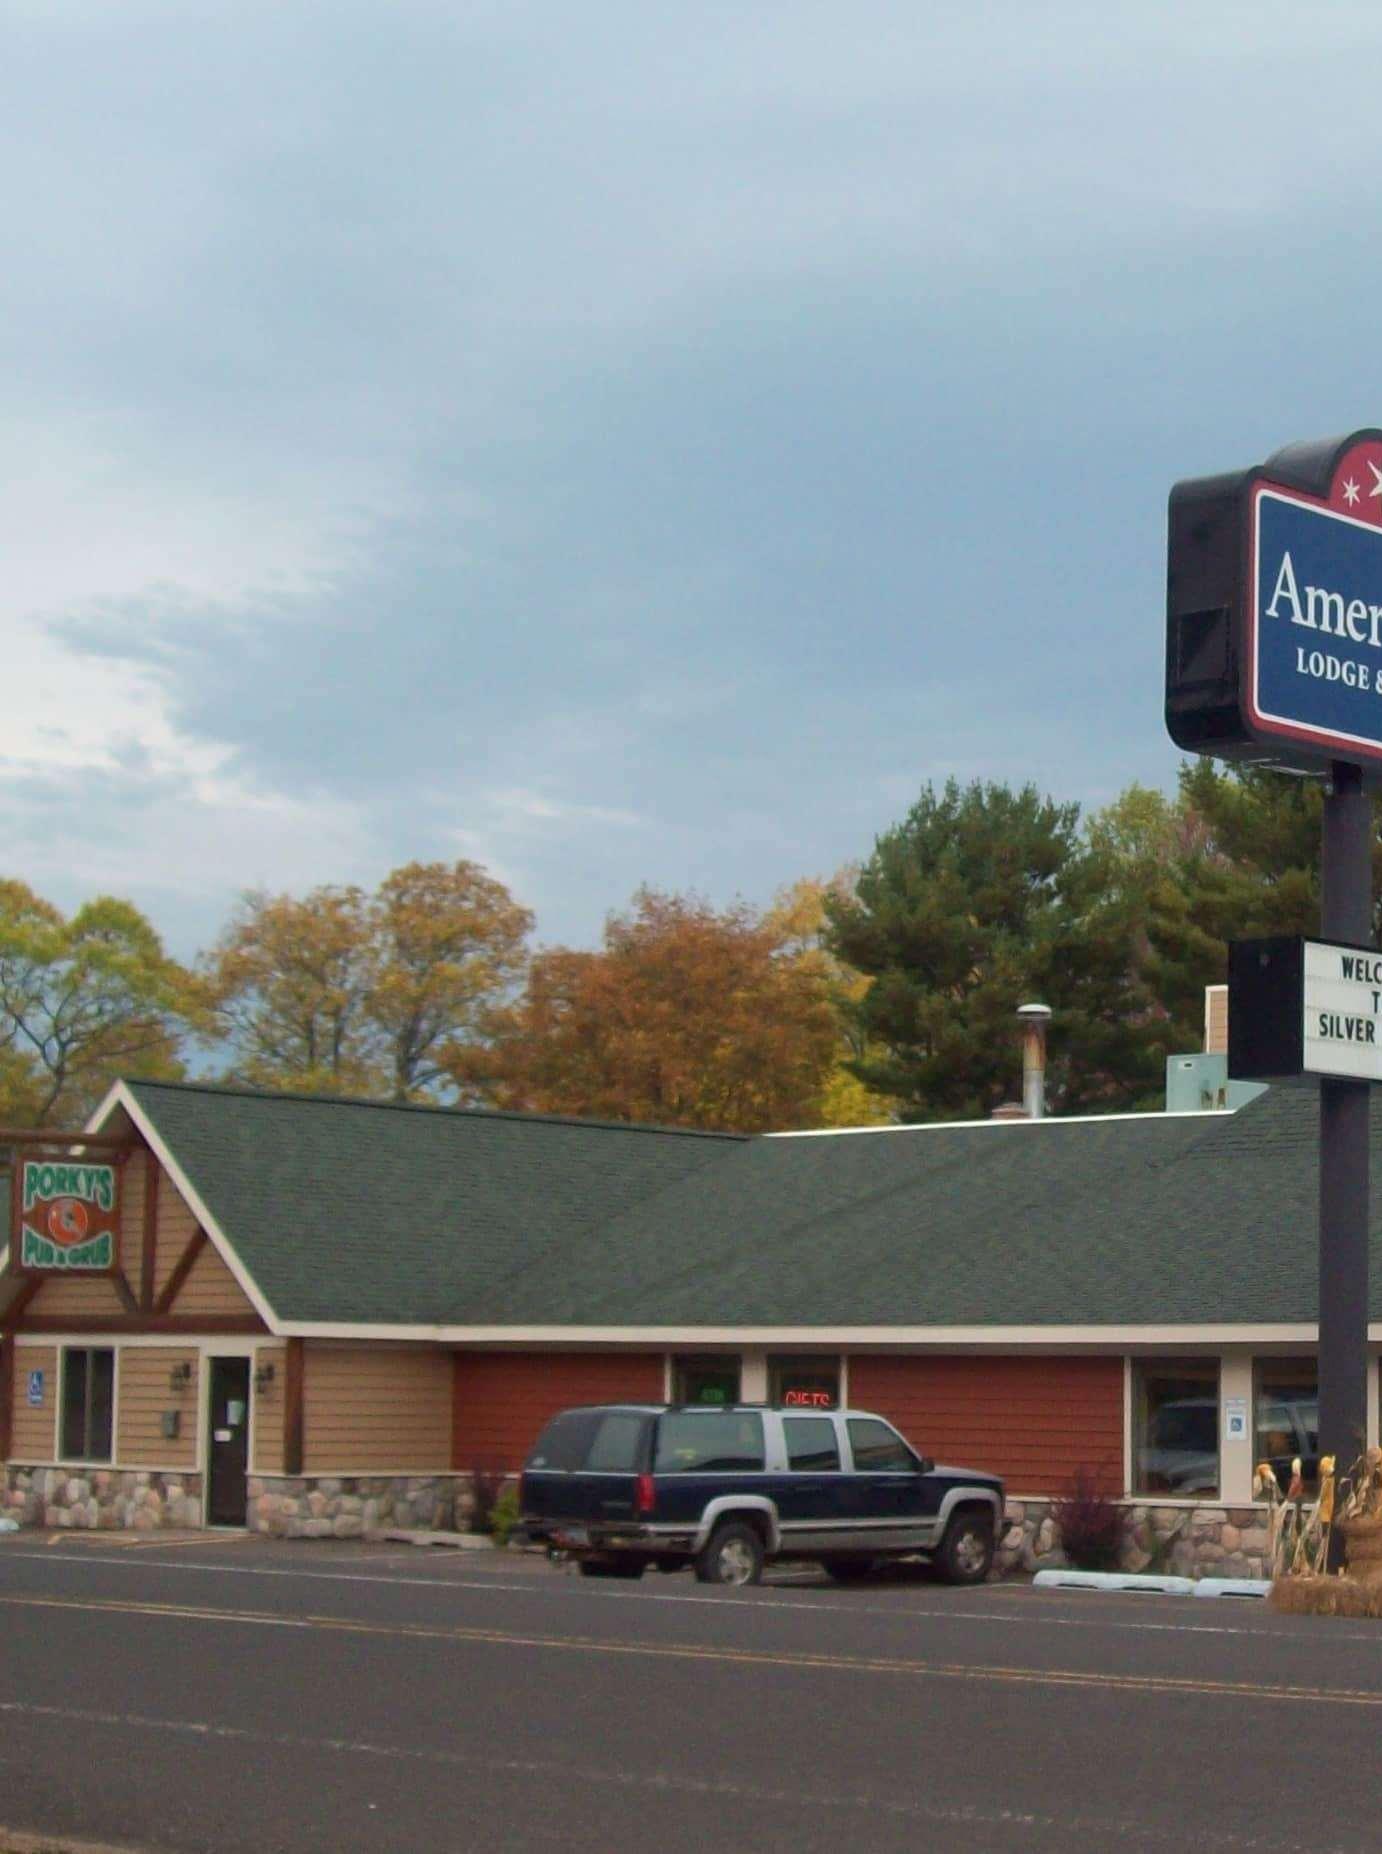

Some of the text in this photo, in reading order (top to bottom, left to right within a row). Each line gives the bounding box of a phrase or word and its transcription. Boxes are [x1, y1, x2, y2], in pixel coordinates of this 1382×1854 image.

[1296, 647, 1370, 691] LODGE
[1319, 1013, 1375, 1043] SILVER
[23, 1162, 114, 1212] PORKY'S
